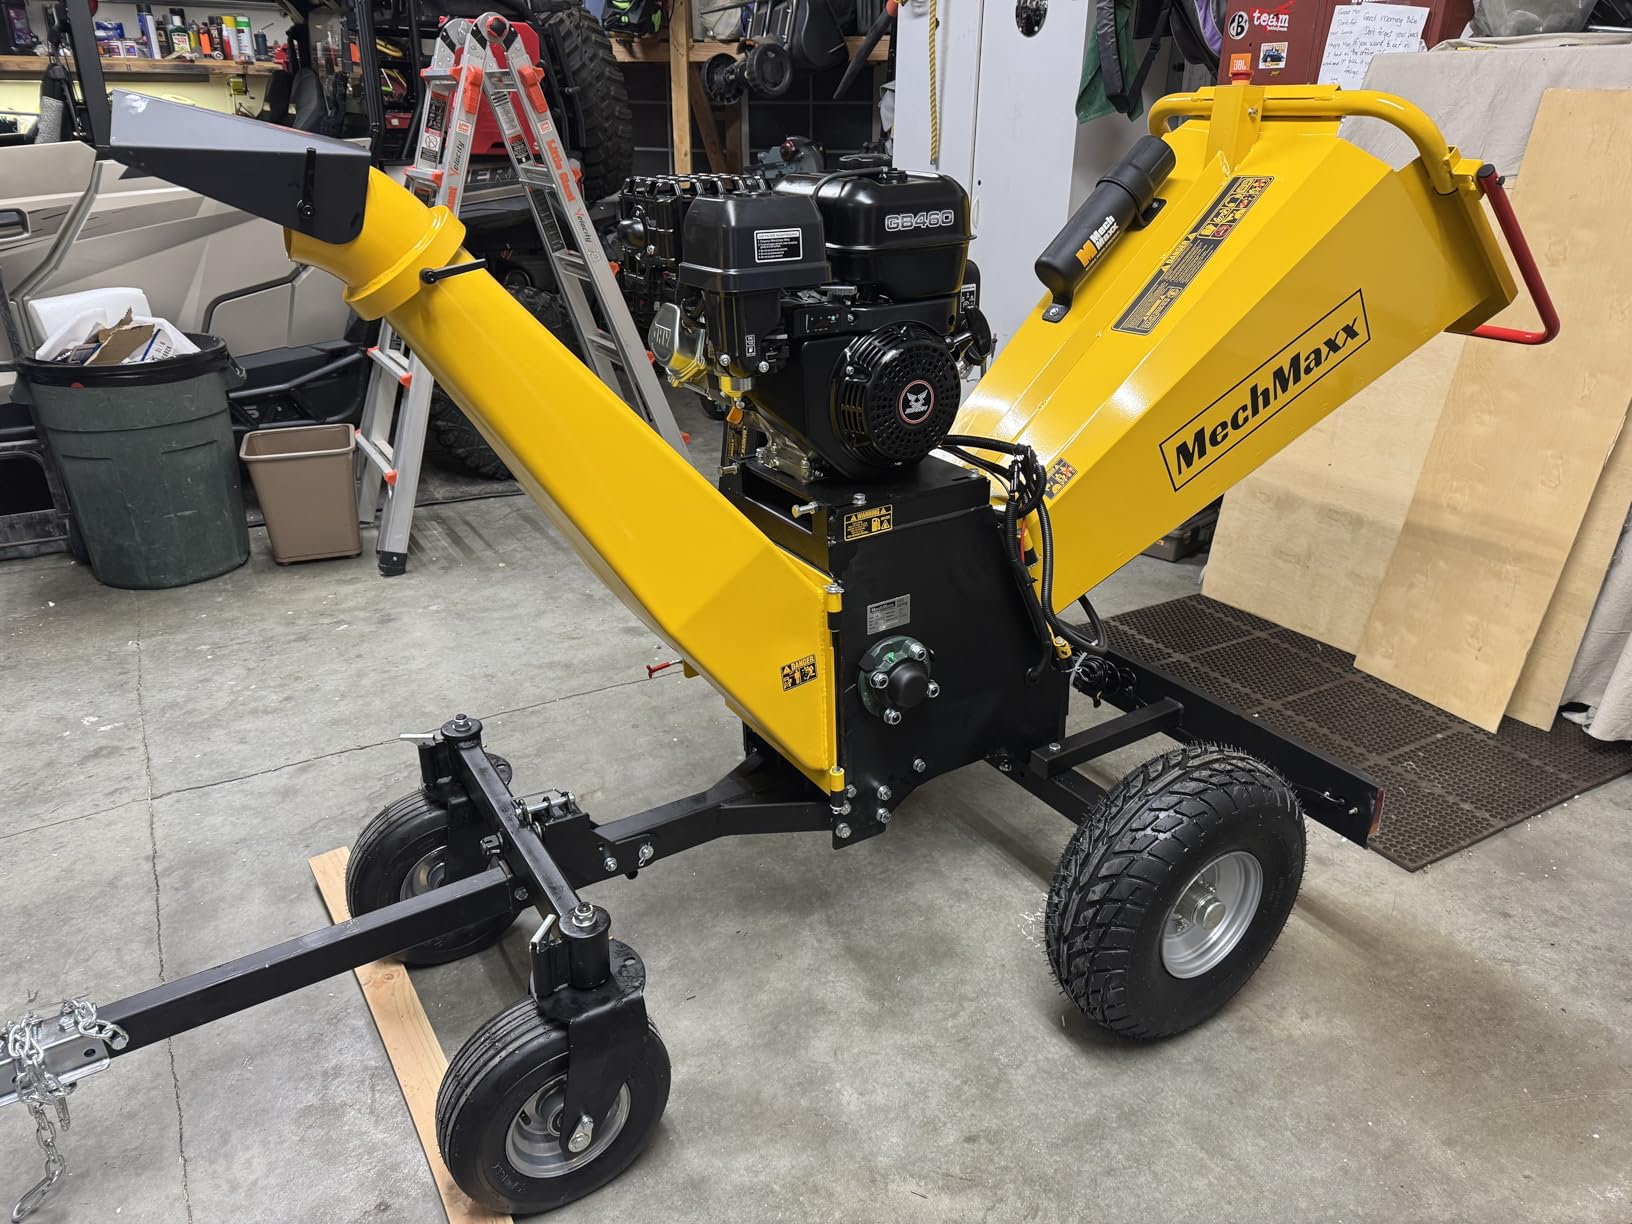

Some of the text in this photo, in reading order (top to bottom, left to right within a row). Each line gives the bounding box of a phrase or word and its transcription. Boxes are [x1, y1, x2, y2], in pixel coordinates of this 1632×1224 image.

[1252, 9, 1289, 27] team
[448, 140, 465, 177] Velocity
[885, 210, 955, 231] GB460
[1089, 215, 1116, 244] Mech
[1095, 222, 1119, 250] Maxx
[1175, 316, 1360, 476] MechMaxx
[790, 655, 814, 671] DANGER
